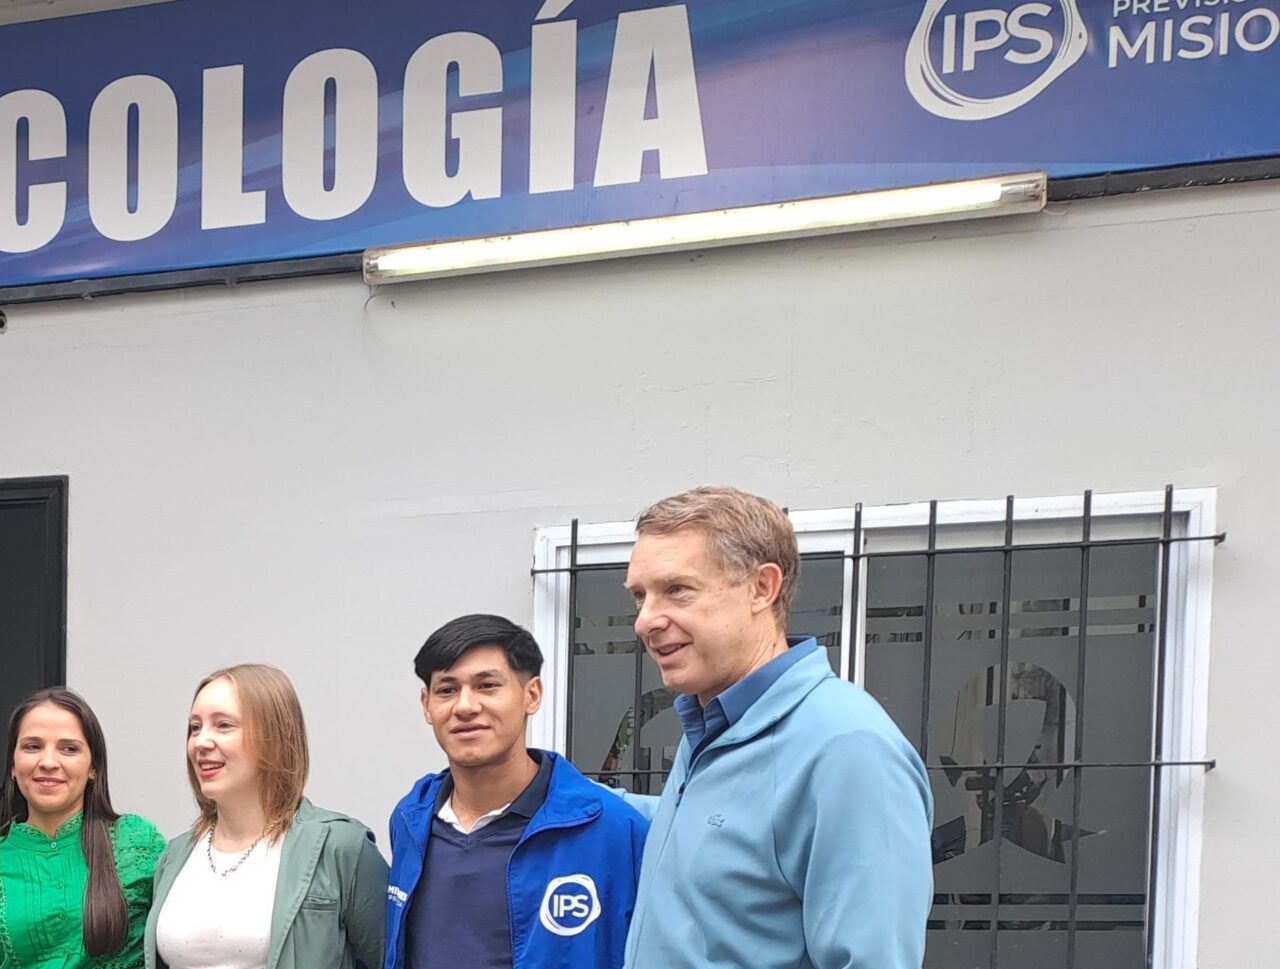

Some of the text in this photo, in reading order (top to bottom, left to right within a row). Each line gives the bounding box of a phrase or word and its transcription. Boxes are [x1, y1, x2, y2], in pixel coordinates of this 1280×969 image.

[941, 3, 1054, 74] IPS
[1108, 7, 1280, 68] MISIO
[553, 894, 589, 918] IPS
